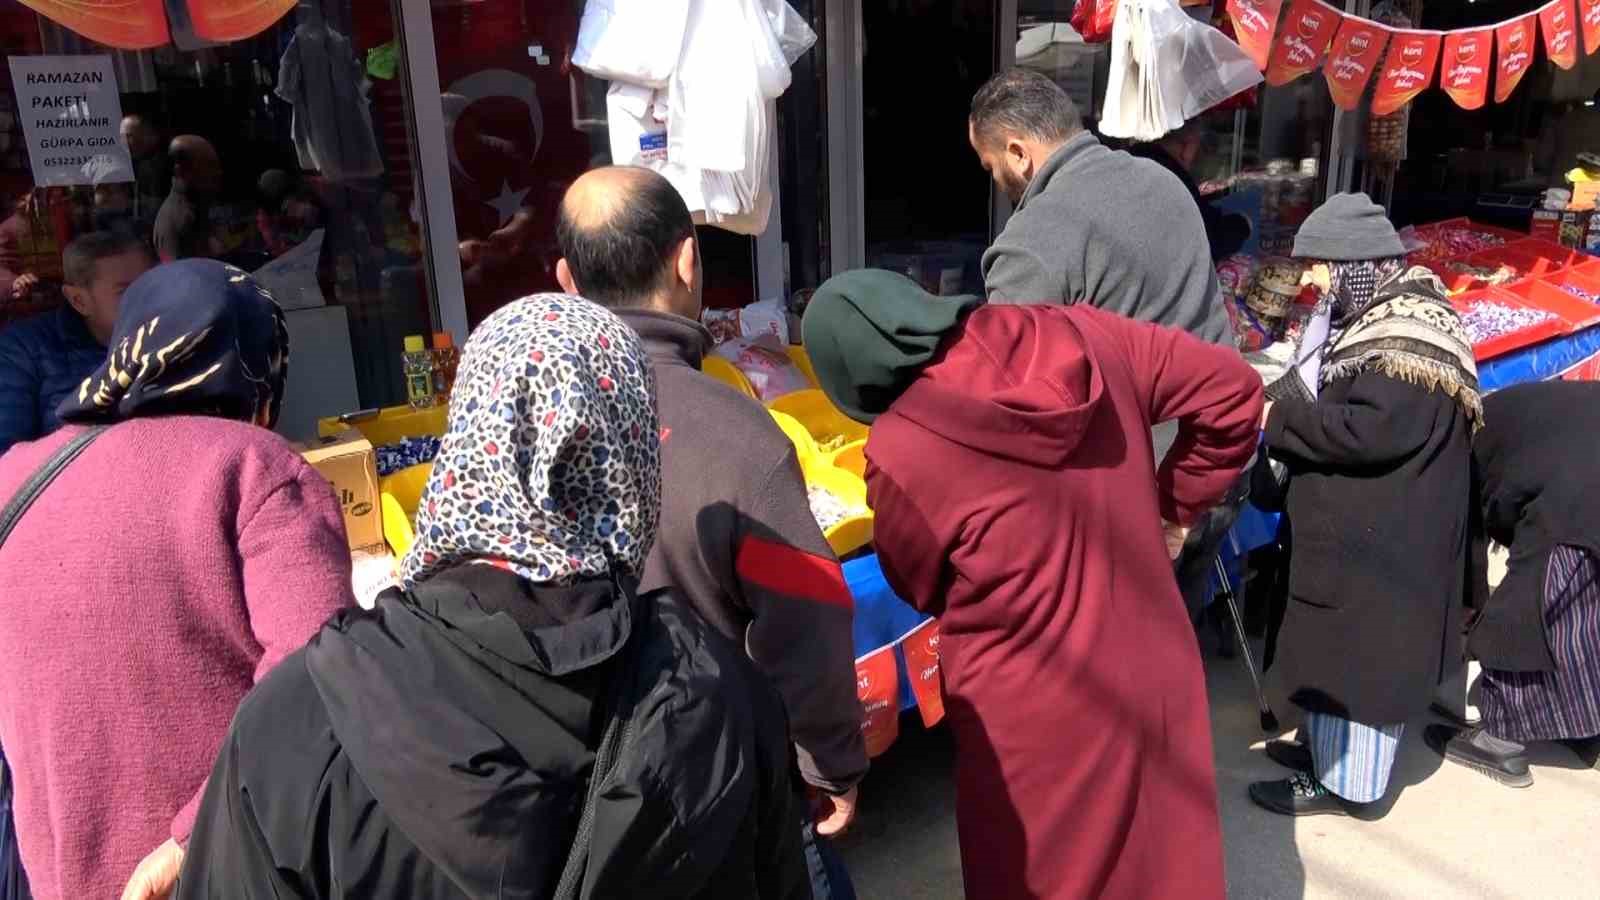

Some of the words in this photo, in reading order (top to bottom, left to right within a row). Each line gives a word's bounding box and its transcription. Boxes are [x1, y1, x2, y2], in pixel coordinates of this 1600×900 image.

[1403, 46, 1423, 56] kent
[26, 71, 103, 85] RAMAZAN
[32, 92, 87, 109] PAKETİ
[40, 136, 84, 149] GÜRPA
[87, 137, 116, 147] GIDA
